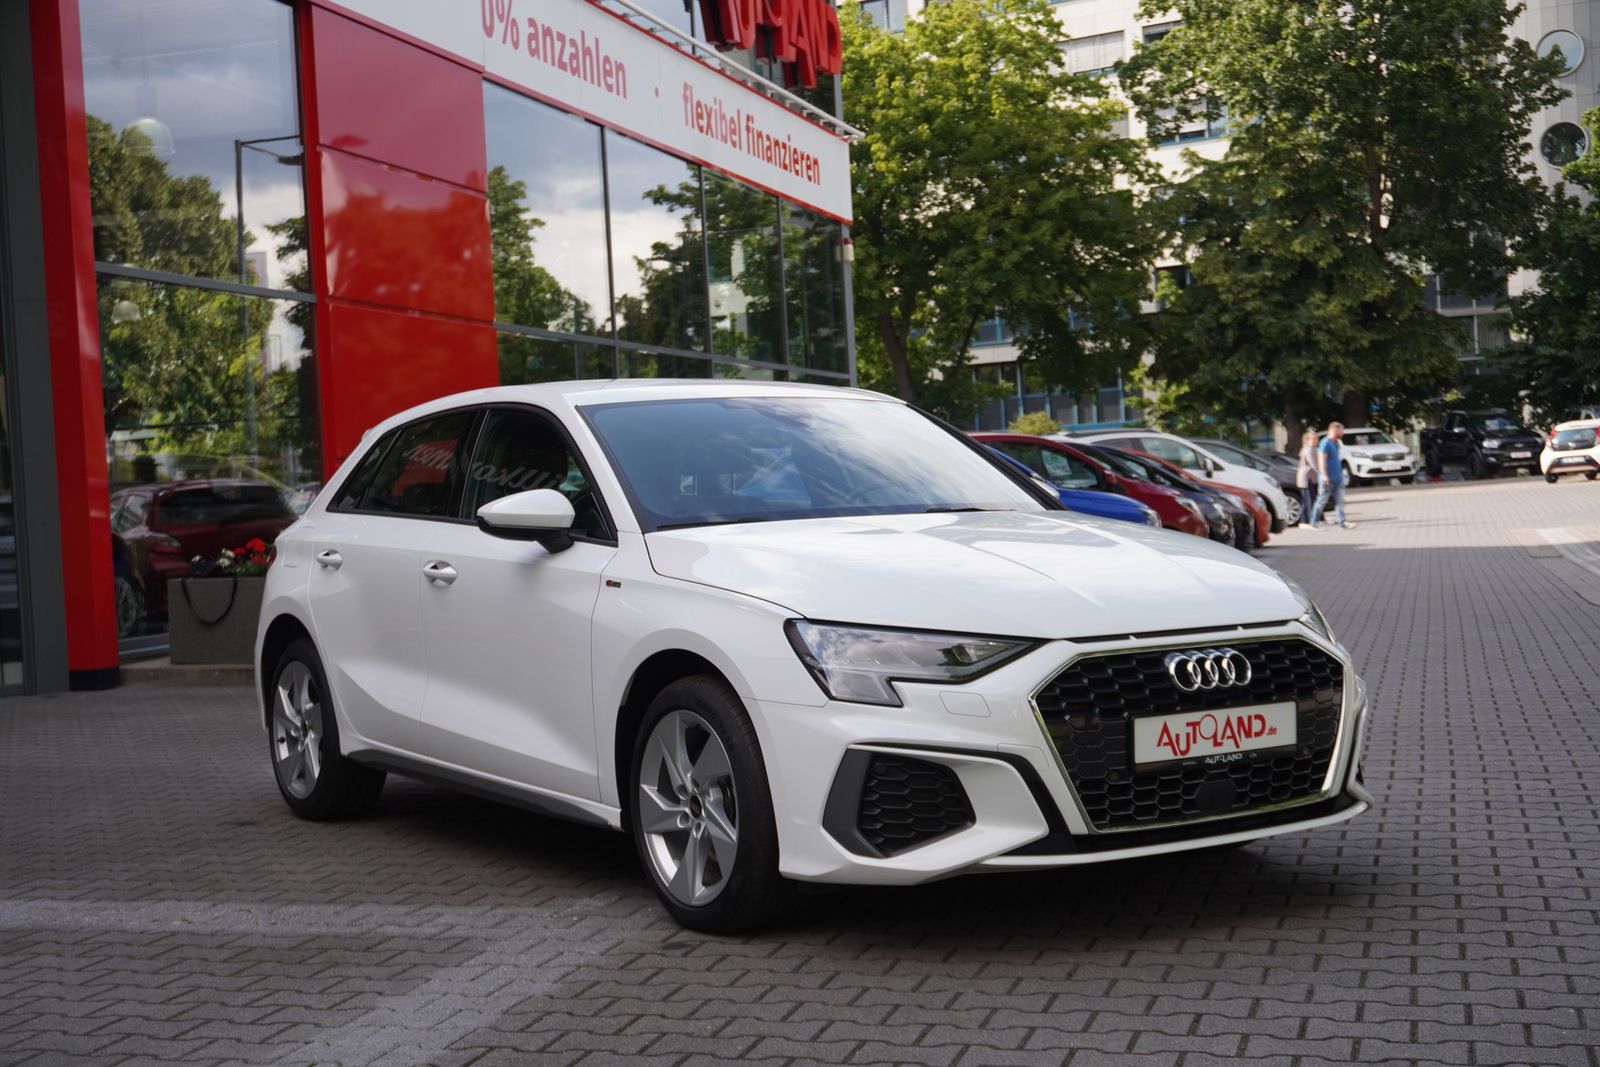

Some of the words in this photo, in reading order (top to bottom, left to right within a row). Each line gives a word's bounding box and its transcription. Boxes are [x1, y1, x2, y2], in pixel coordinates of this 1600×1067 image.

[526, 16, 627, 99] anzahlen
[682, 82, 743, 151] flexibel
[745, 113, 821, 186] finanzieren
